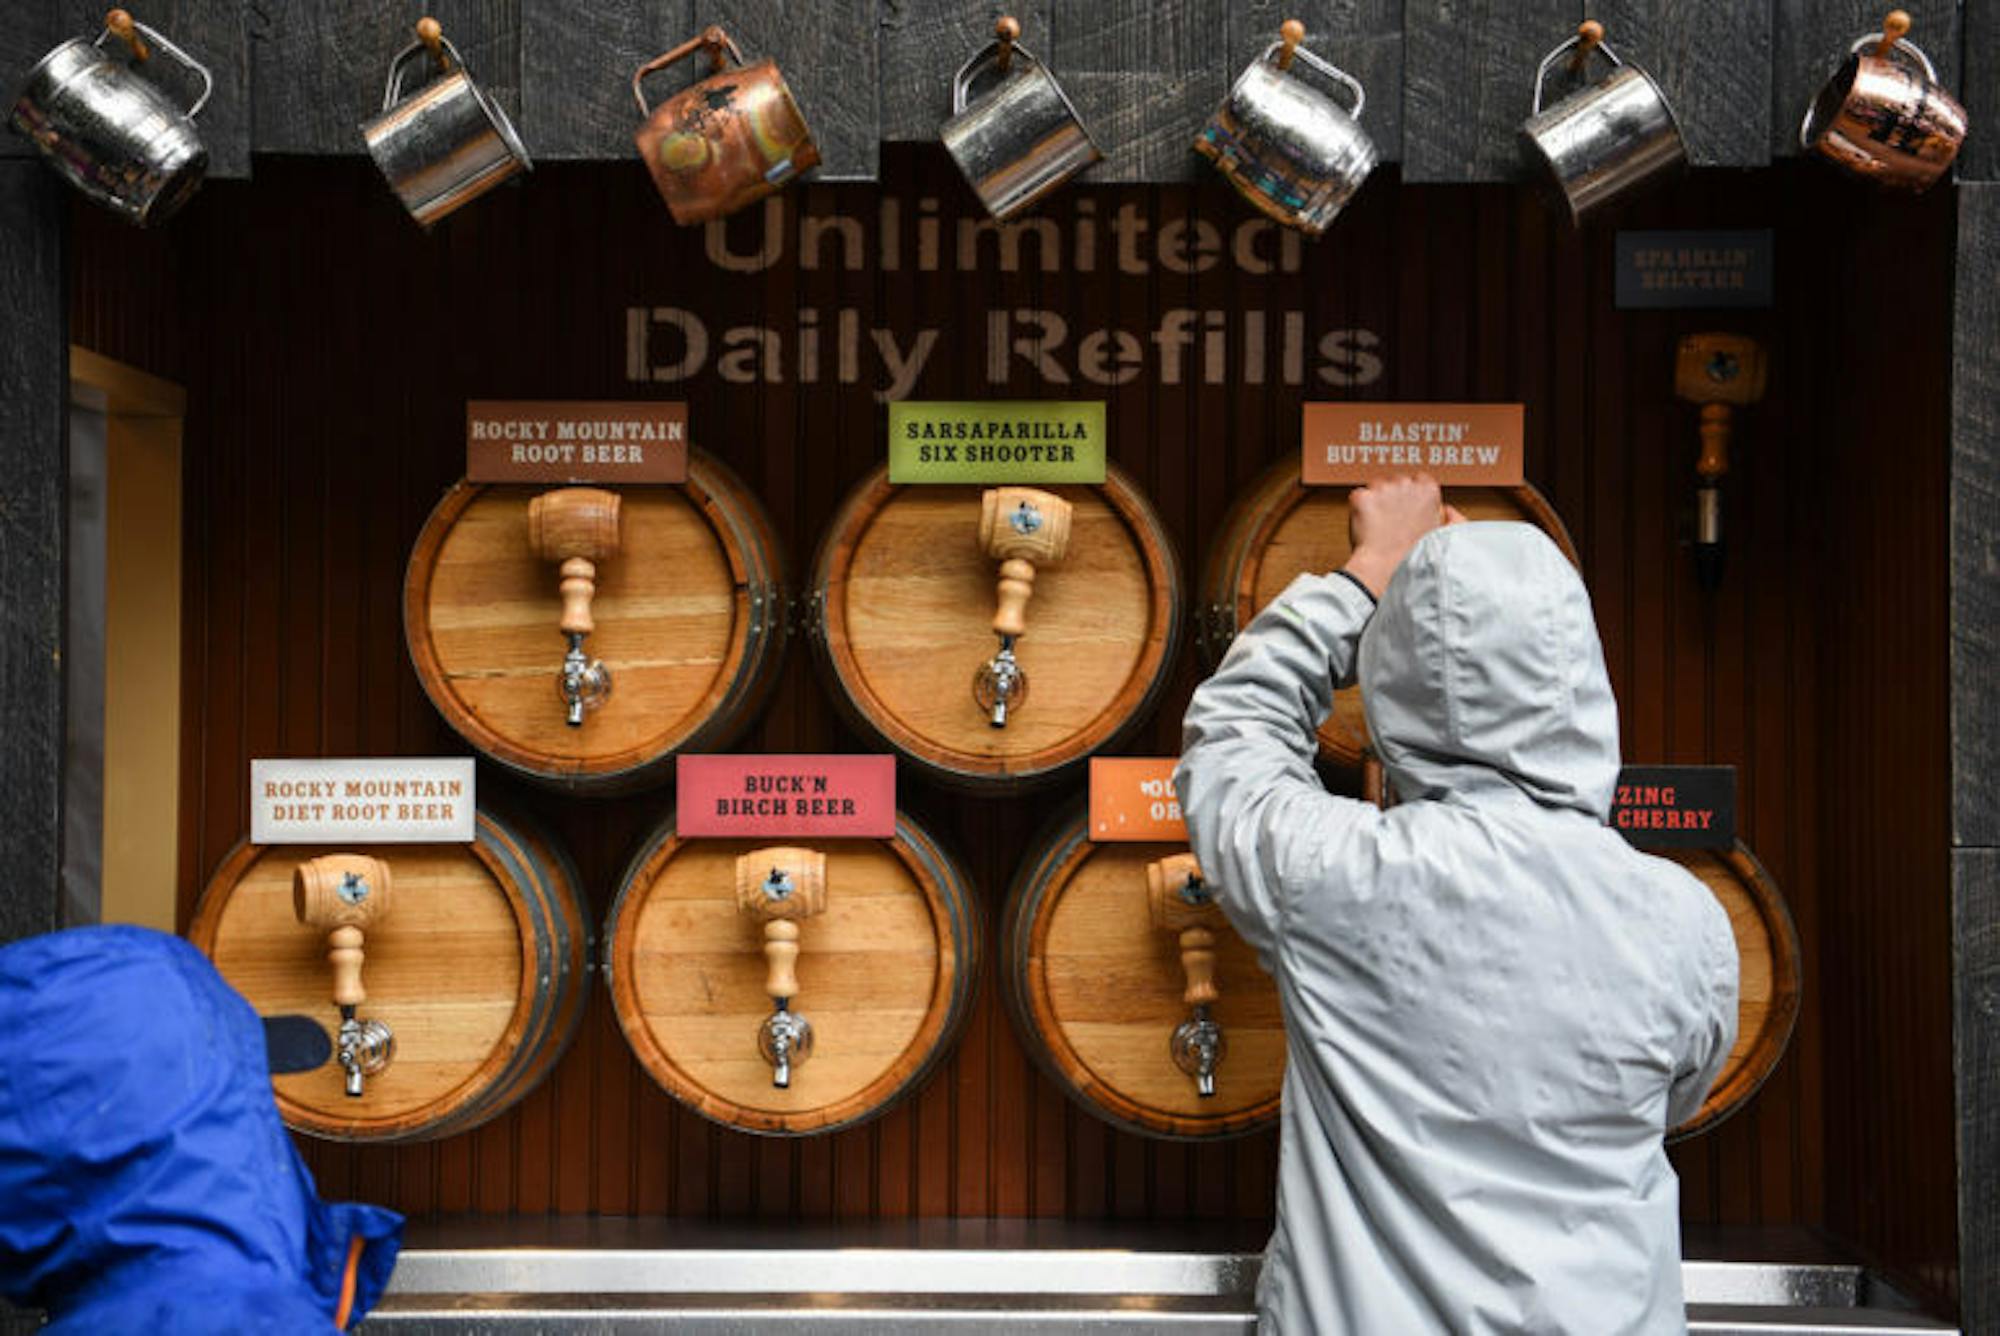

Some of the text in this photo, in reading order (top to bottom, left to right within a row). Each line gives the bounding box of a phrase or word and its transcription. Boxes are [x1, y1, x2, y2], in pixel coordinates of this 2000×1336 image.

[702, 199, 1301, 274] Unlimited
[625, 306, 1383, 400] Daily Refills
[472, 421, 683, 441] ROCKY MOUNTAIN
[906, 422, 1087, 439] SARSAPARILLA
[1359, 422, 1469, 442] BLASTIN'
[512, 443, 643, 463] ROOT BEER
[920, 446, 1075, 463] SIX SHOOTER
[1327, 445, 1499, 465] BUTTER BREW
[265, 781, 463, 798] ROCKY MOUNTAIN
[745, 775, 827, 793] BUCK'N
[1612, 785, 1676, 806] ZING
[274, 804, 454, 821] DIET ROOT BEER
[716, 798, 856, 816] BIRCH BEER
[1617, 808, 1713, 829] CHERRY
